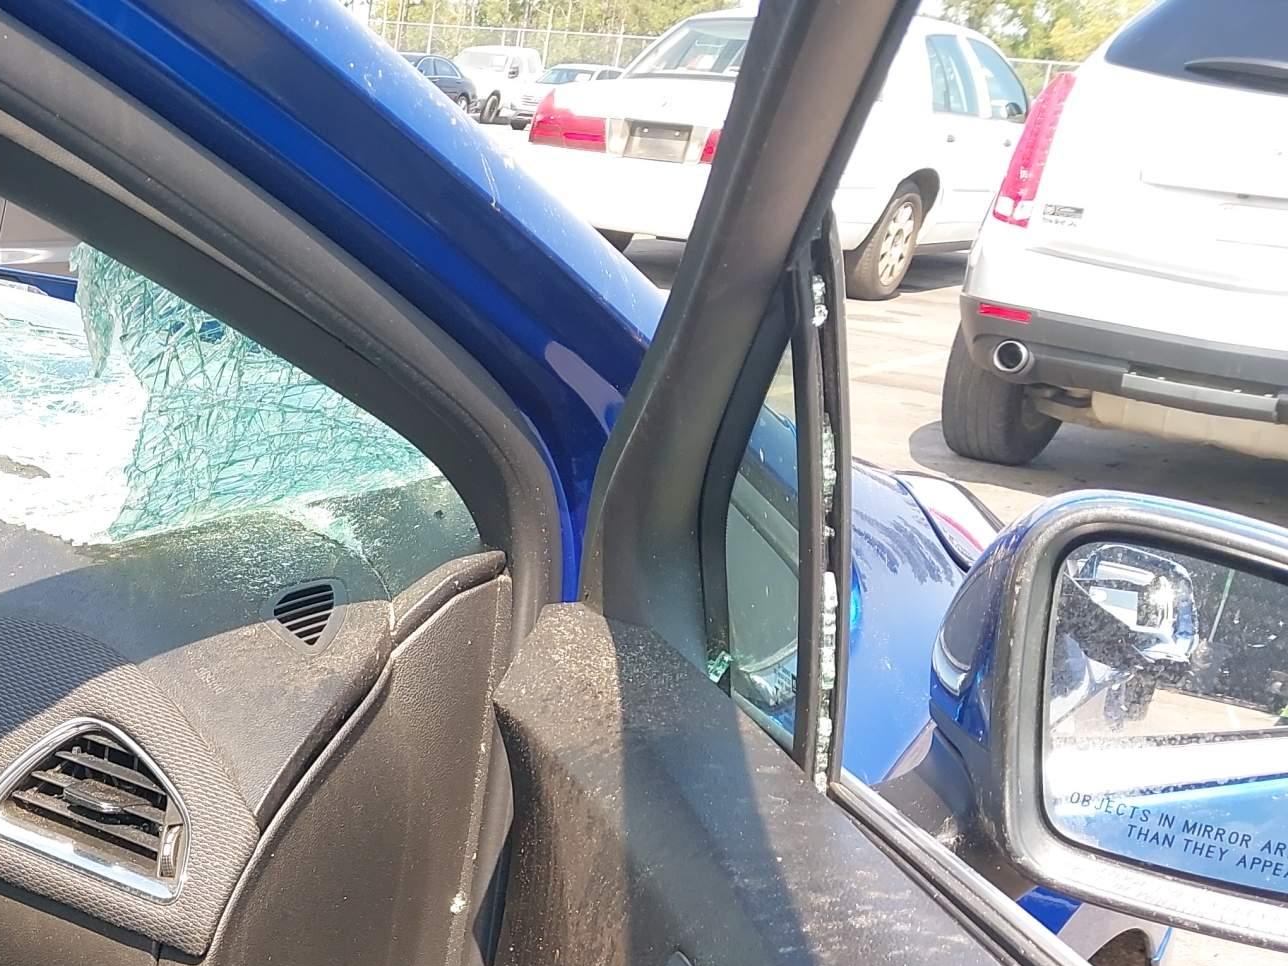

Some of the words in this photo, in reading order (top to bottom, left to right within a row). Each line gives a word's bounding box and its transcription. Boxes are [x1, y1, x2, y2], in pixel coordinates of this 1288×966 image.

[1070, 791, 1151, 822] OBJECTS
[1158, 812, 1176, 829] IN
[1182, 819, 1252, 849] MIRROR
[1260, 839, 1288, 859] AR
[1127, 824, 1176, 849] THAN
[1183, 838, 1230, 862] THEY
